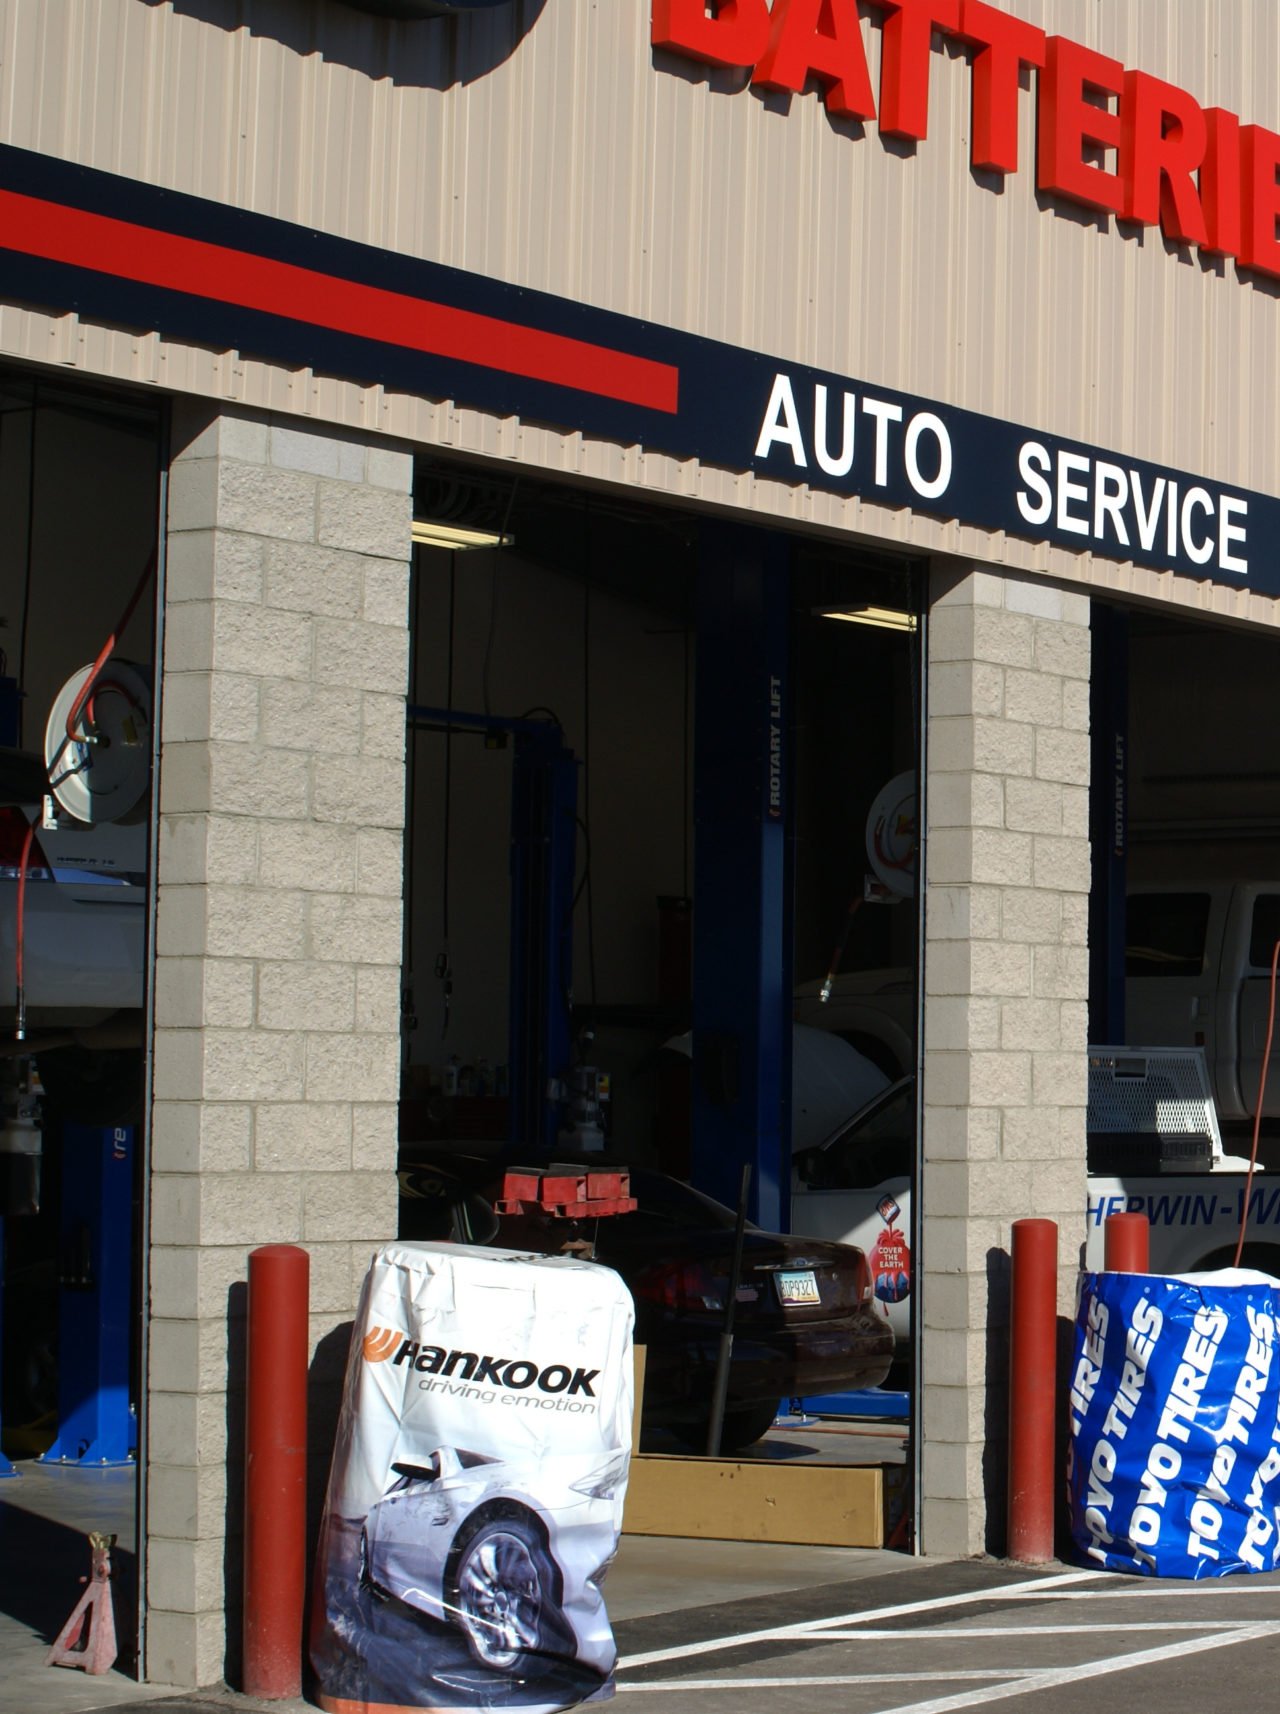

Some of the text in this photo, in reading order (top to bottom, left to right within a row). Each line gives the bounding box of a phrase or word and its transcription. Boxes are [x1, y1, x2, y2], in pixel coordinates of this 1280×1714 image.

[754, 373, 954, 499] AUTO
[1016, 441, 1249, 574] SERVICE
[769, 676, 782, 806] ROTARY LIFT
[1114, 733, 1124, 770] LIFT
[878, 1246, 903, 1255] COVER
[879, 1261, 904, 1269] EARTH
[417, 1376, 596, 1415] driving emotion
[1102, 1297, 1164, 1440] TIRES
[1157, 1304, 1229, 1443] TIRES
[1187, 1305, 1275, 1560] TOYO TIRES
